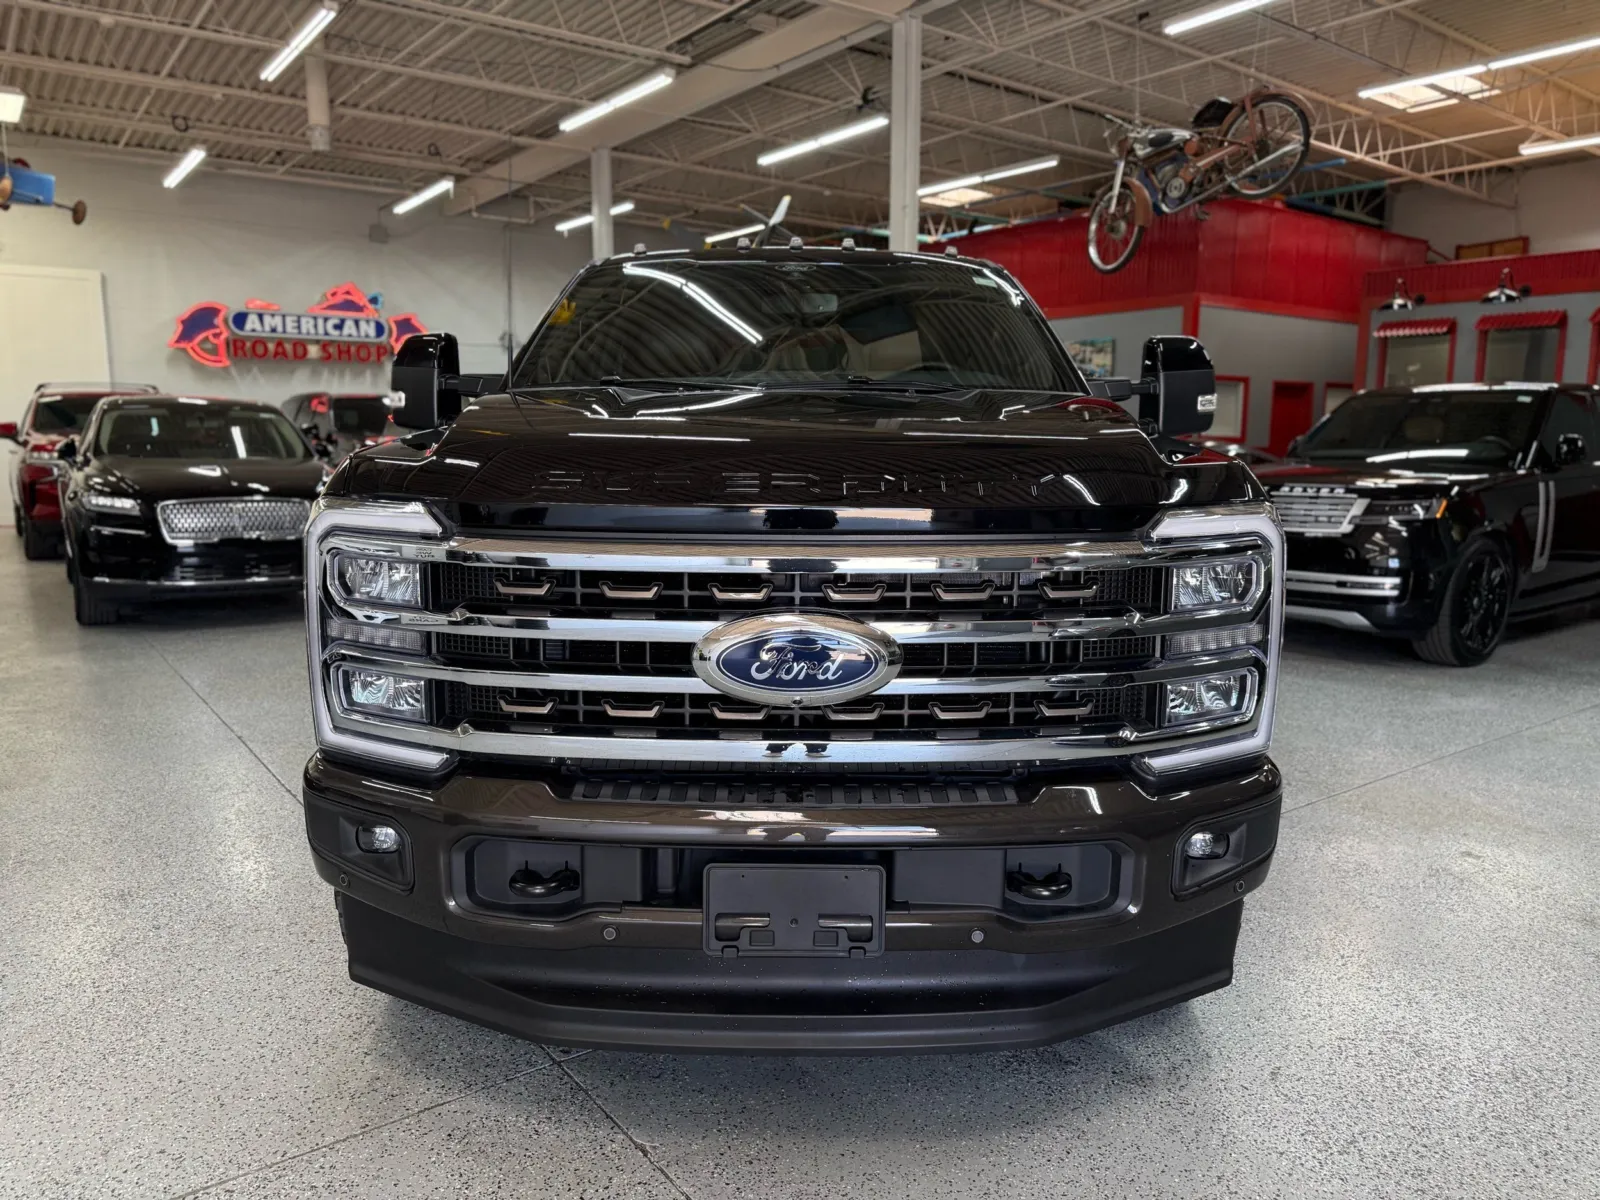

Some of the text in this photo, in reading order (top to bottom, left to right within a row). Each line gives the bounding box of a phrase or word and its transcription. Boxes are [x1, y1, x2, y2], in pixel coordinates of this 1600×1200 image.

[243, 312, 377, 338] AMERICAN
[231, 337, 389, 363] ROAD SHOP
[750, 642, 844, 681] Ford
